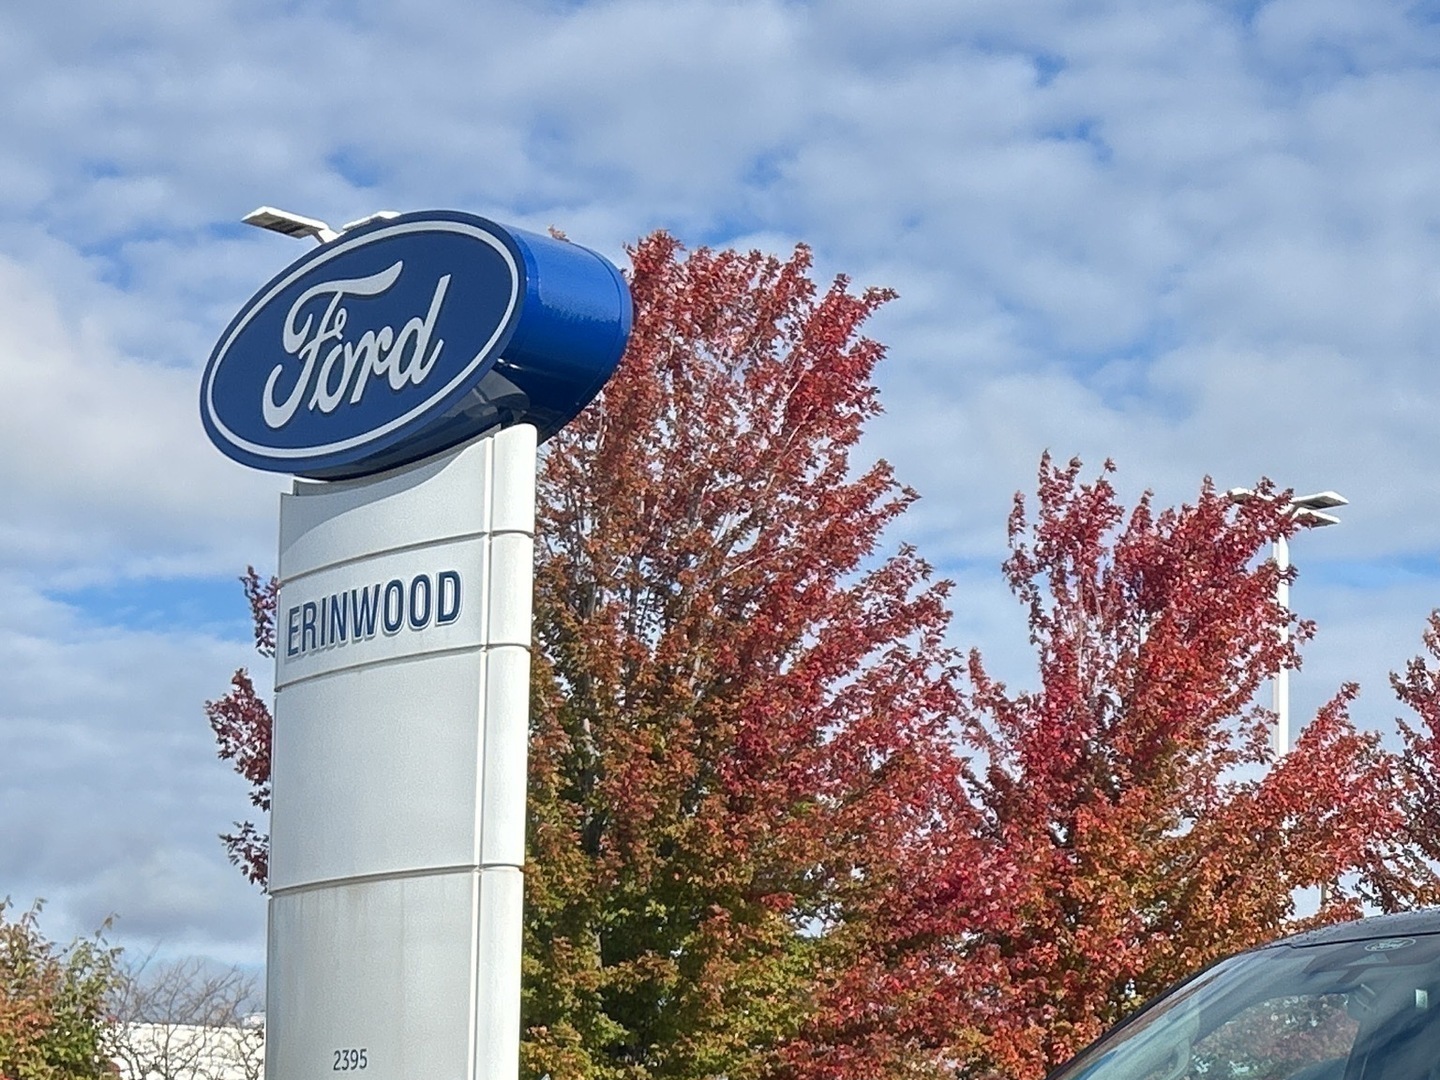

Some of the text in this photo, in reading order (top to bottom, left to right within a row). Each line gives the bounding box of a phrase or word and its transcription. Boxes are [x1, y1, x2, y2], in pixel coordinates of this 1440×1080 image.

[262, 260, 452, 429] Ford
[286, 570, 463, 657] ERINWOOD
[332, 1048, 368, 1072] 2395
